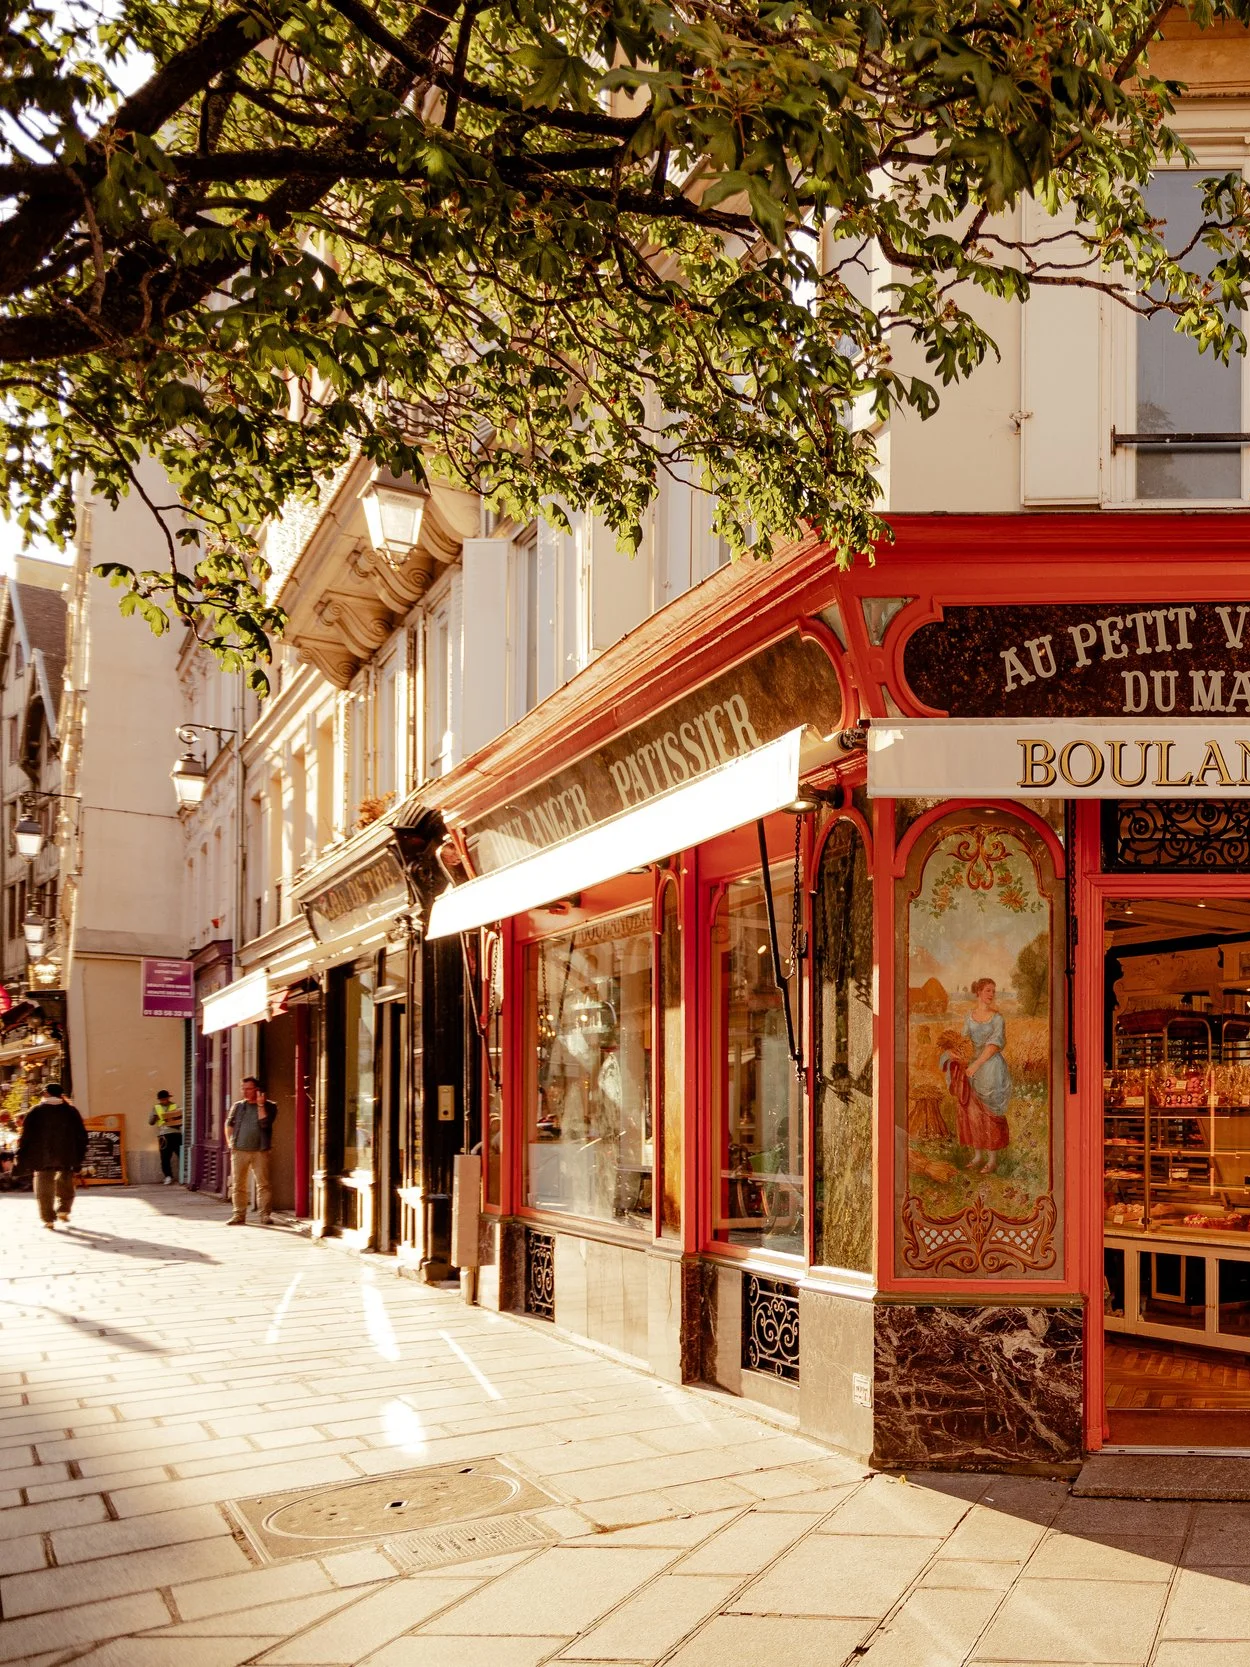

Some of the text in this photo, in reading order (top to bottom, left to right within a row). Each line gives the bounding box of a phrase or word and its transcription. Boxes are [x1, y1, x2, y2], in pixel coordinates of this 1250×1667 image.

[999, 634, 1057, 692] AU
[1067, 606, 1196, 668] PETIT
[1120, 670, 1179, 713] DU
[609, 694, 763, 809] PATISSIER
